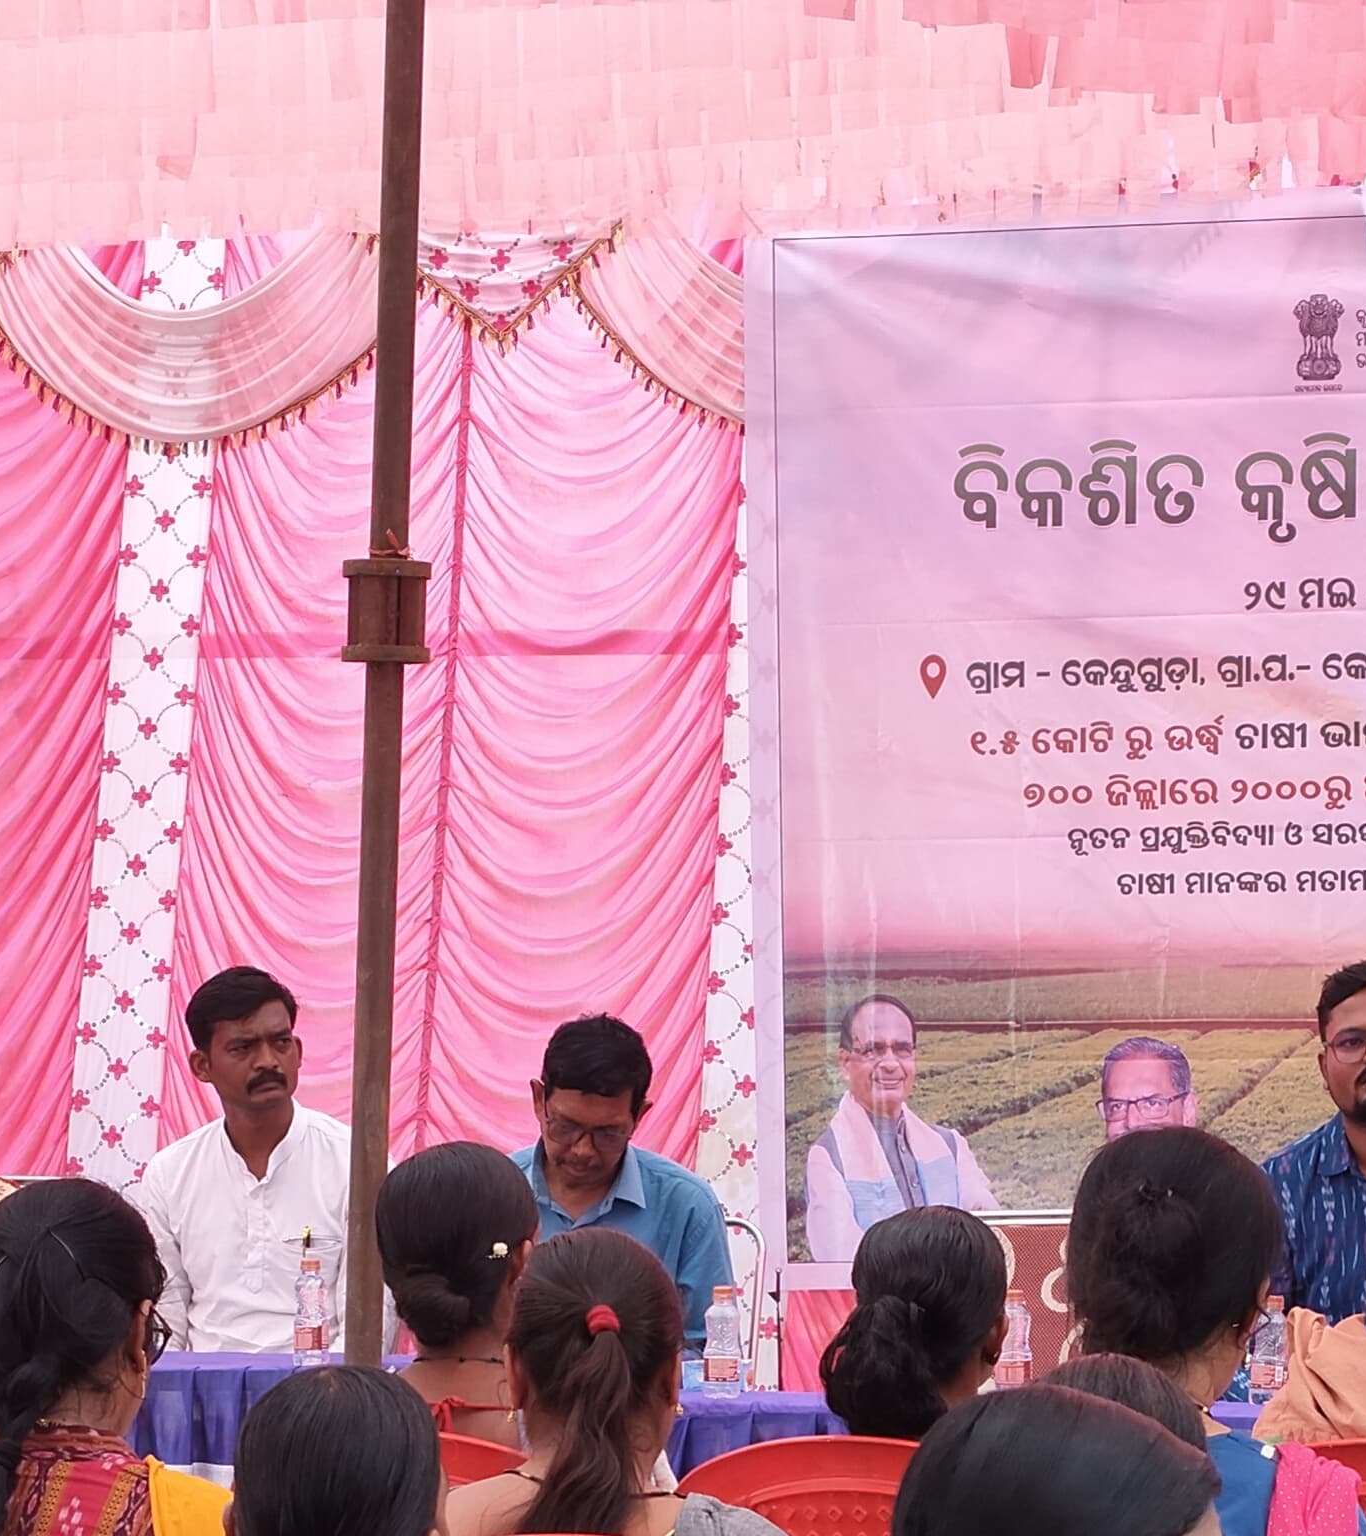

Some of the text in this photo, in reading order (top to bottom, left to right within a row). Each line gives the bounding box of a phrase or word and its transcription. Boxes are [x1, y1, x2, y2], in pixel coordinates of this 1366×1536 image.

[954, 439, 1203, 528] ବିକଶିତ
[1235, 432, 1356, 543] କୃଷି
[1244, 581, 1285, 610] ୨୯
[1299, 577, 1356, 609] ମଇ
[966, 660, 1024, 694] ଗ୍ରାମ
[971, 730, 1019, 755] ୧.୫
[1032, 720, 1113, 754] କୋଟି
[1125, 725, 1153, 760] ରୁ
[1235, 722, 1307, 749] ଚାଷୀ
[1024, 783, 1092, 808] ୭୦୦
[1231, 775, 1352, 810] ୨୦୦୦ରୁ
[1068, 827, 1130, 856] ନୂତନ
[1285, 821, 1302, 845] ଓ
[1117, 872, 1174, 895] ଚାଷୀ
[1185, 870, 1286, 894] ମାନଙ୍କର
